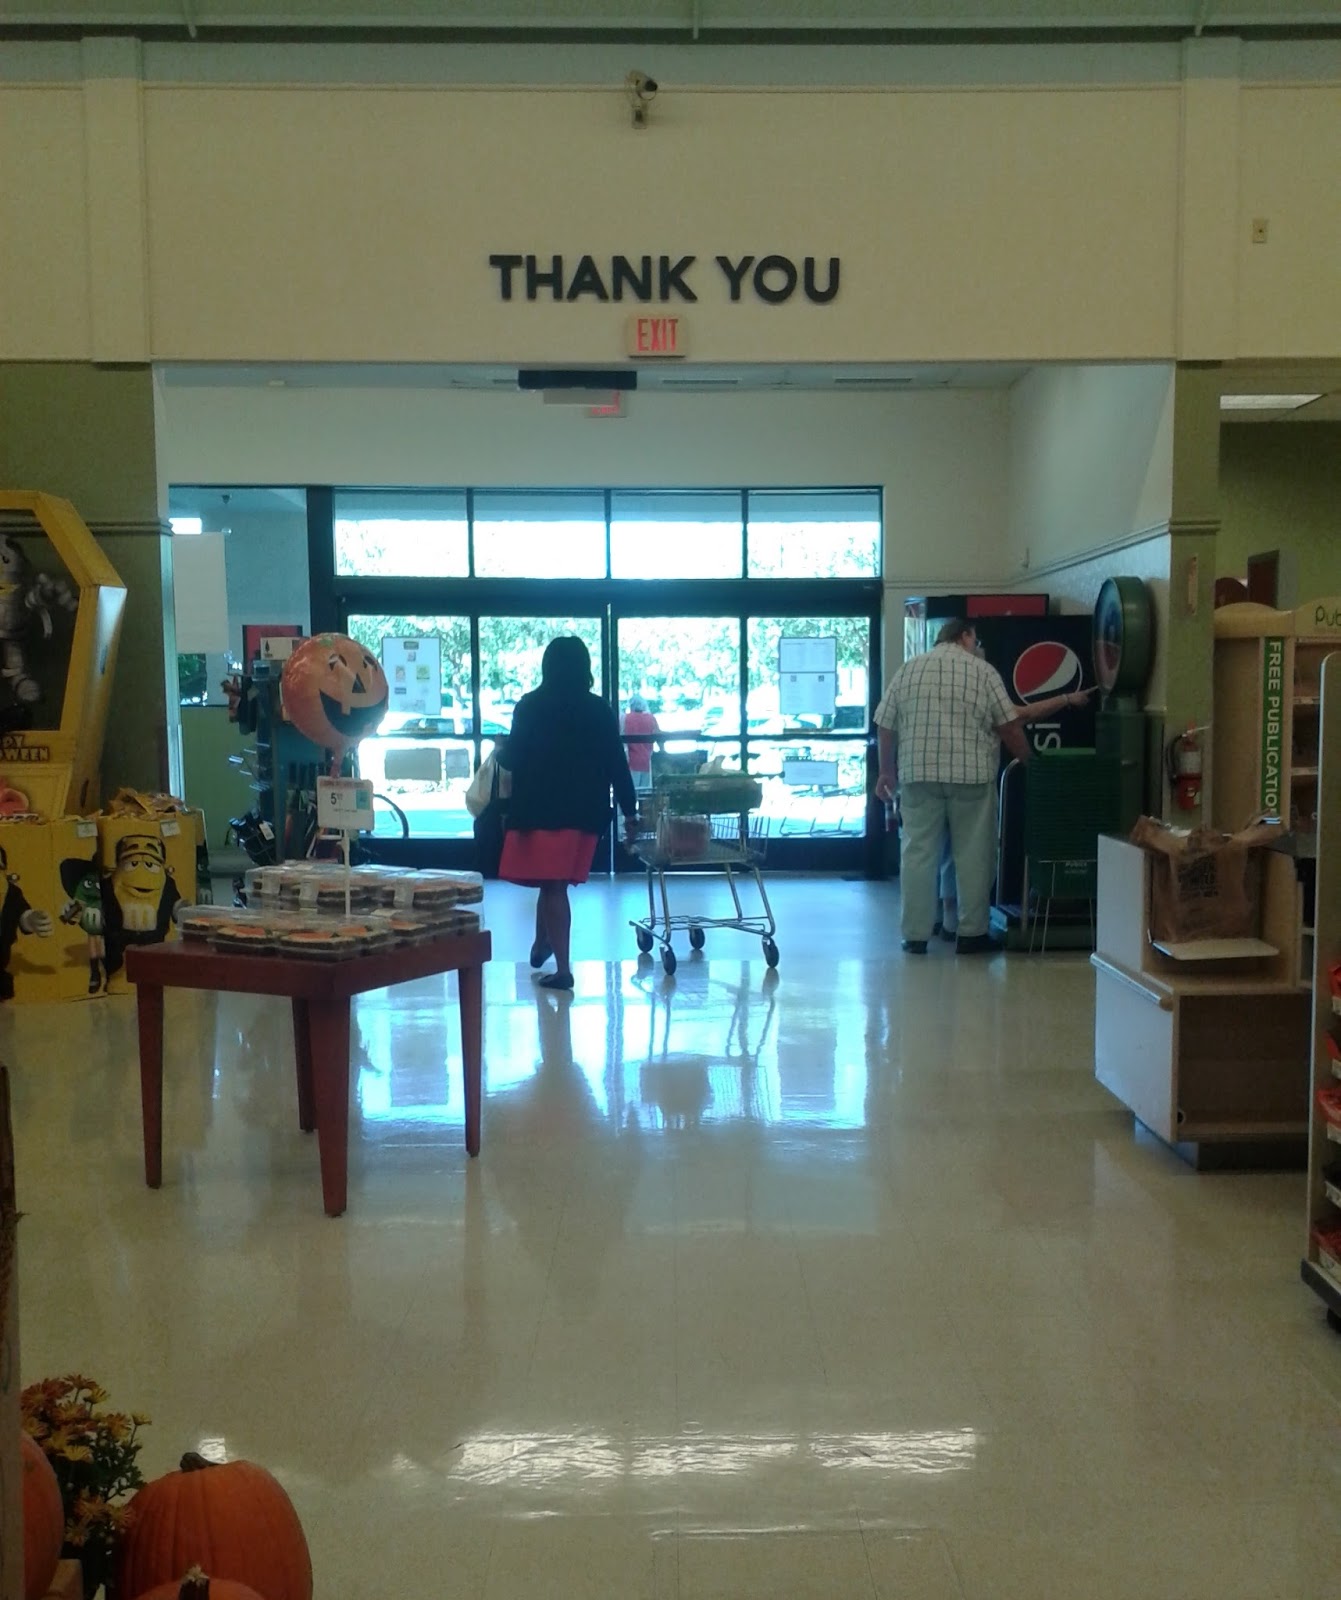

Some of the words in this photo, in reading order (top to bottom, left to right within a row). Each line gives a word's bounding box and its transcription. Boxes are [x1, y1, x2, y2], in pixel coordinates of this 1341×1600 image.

[489, 254, 698, 301] THANK
[716, 254, 841, 304] YOU
[637, 318, 679, 351] EXIT
[1268, 641, 1282, 690] FREE
[0, 735, 24, 749] DY
